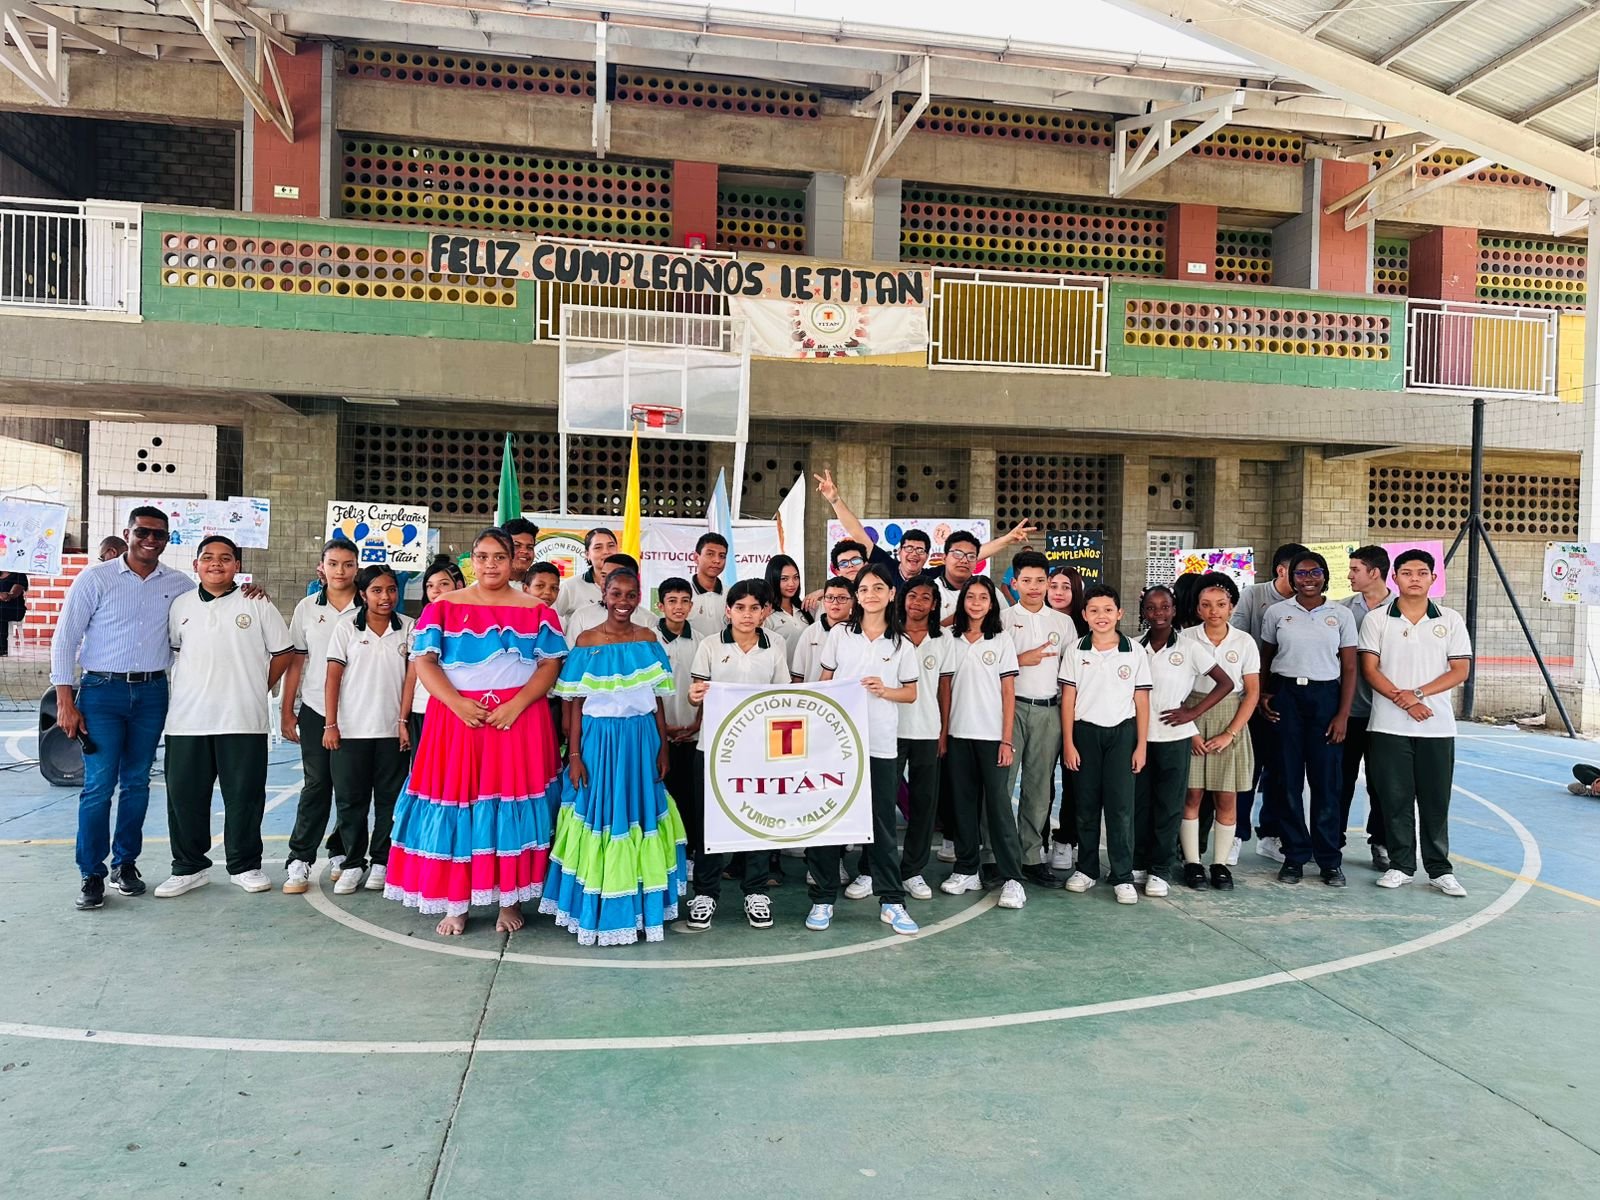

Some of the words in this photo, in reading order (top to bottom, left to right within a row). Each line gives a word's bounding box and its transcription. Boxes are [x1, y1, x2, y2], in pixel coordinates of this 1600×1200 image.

[431, 234, 521, 277] FELIZ
[532, 244, 765, 296] CUMPLEAÑOS
[332, 504, 366, 523] Feliz
[368, 504, 427, 531] Cumpleaños
[387, 550, 419, 563] Titán
[734, 553, 772, 564] CATIVA
[1045, 547, 1101, 561] CUMPLEAÑOS
[720, 696, 792, 763] INSTITUCIÓN
[796, 698, 853, 761] EDUCATIVA
[772, 720, 803, 755] T
[728, 771, 846, 795] TITÁN
[739, 801, 786, 829] YUMBO
[796, 797, 838, 827] VALLE
